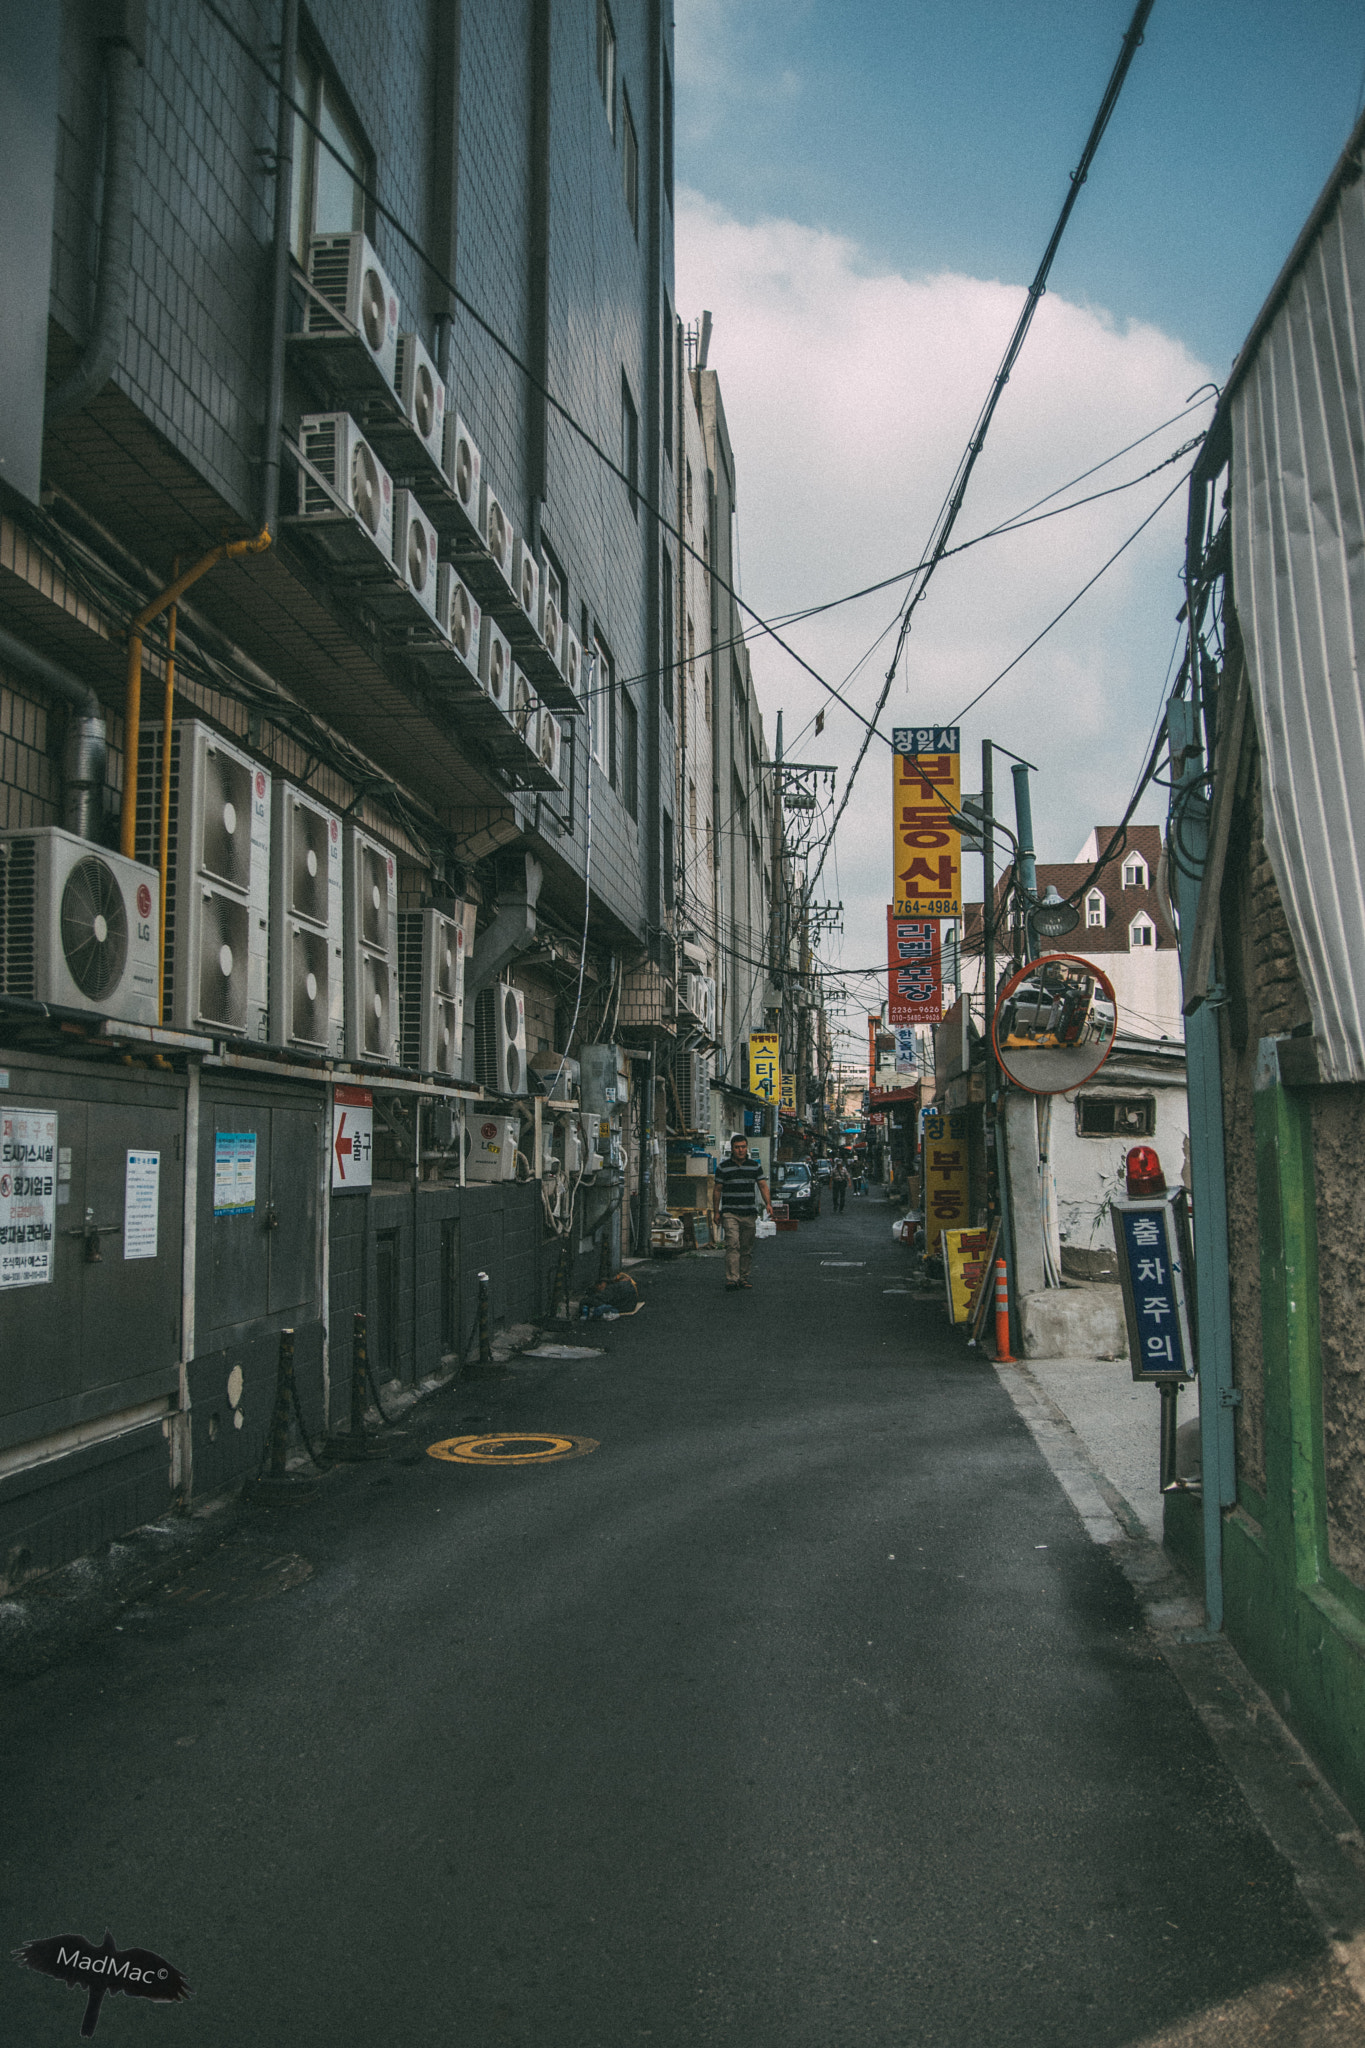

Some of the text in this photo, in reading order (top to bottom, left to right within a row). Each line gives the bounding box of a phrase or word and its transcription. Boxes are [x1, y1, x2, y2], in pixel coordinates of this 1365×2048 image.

[894, 730, 957, 752] 창일사
[255, 801, 264, 817] LG
[899, 756, 958, 899] 부동산
[896, 900, 958, 914] 764-4984
[138, 922, 150, 941] LG
[891, 1006, 940, 1014] 2236-9626
[927, 1117, 967, 1141] 창일
[2, 1144, 53, 1162] 도시가스시설
[353, 1131, 371, 1161] 출구
[13, 1176, 52, 1196] 화기엄금
[1132, 1218, 1173, 1362] 출차주의
